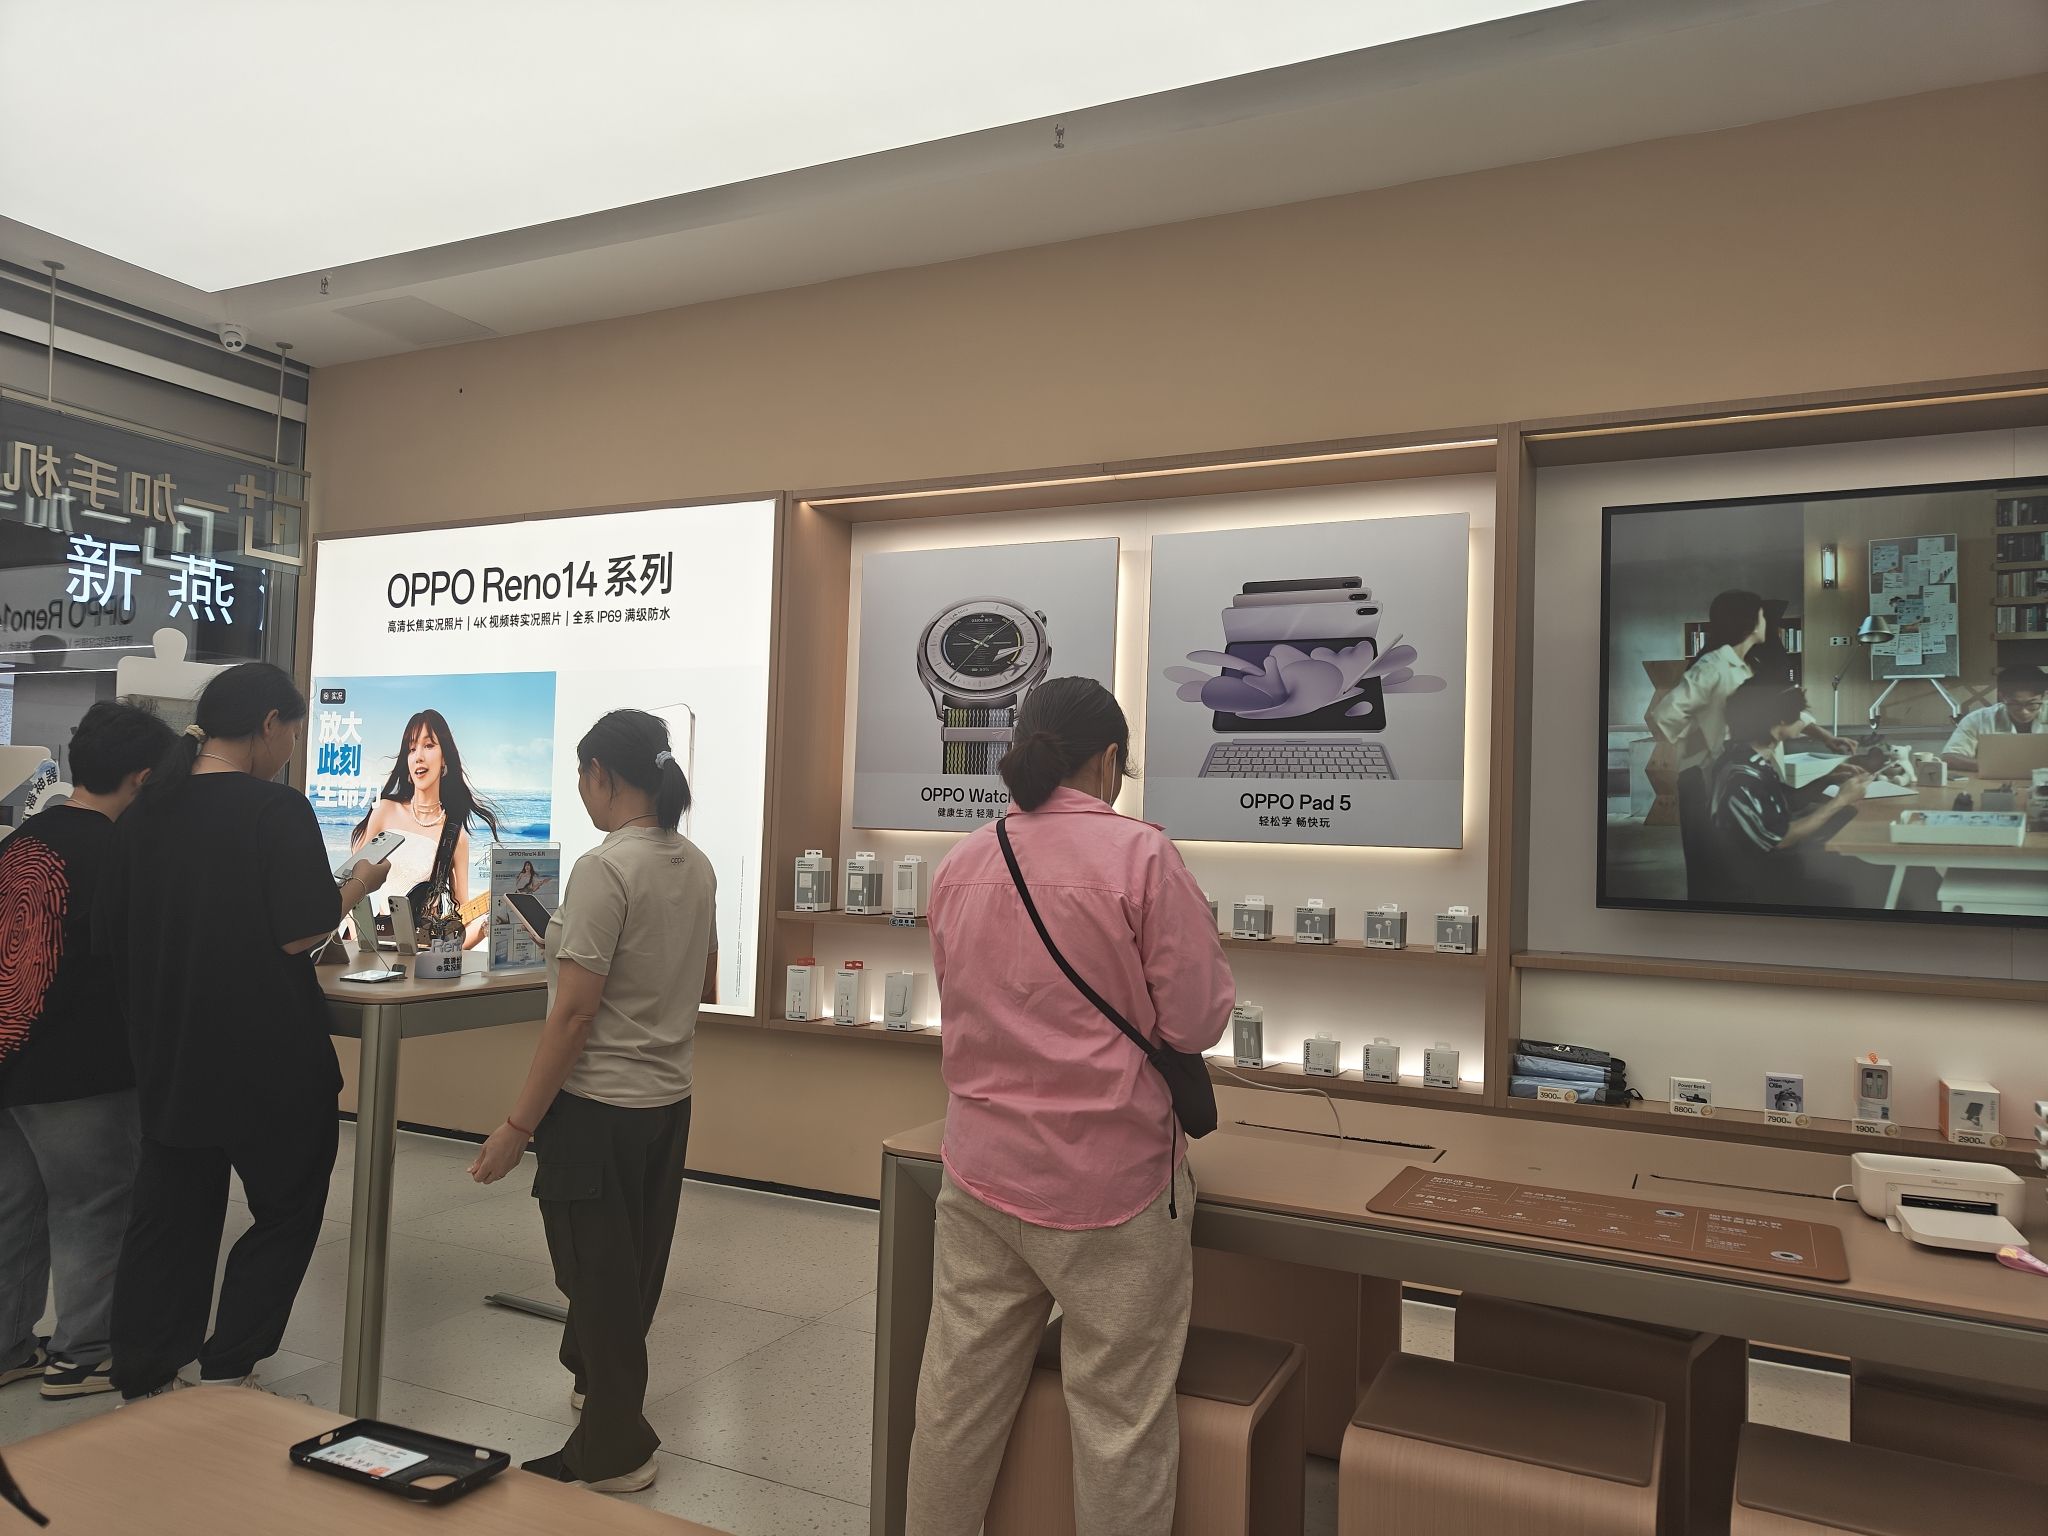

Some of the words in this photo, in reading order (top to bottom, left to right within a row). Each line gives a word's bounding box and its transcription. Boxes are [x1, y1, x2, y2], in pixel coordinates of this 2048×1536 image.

[387, 568, 475, 608] OPPO
[482, 560, 597, 603] Reno14
[604, 551, 673, 597] 系列
[387, 617, 463, 633] 高清长焦实况照片
[473, 616, 487, 629] 4K
[489, 612, 562, 628] 视频转实况照片
[573, 611, 594, 624] 全系
[597, 609, 622, 623] IP69
[625, 606, 671, 622] 满级防水
[319, 711, 362, 742] 放大
[317, 743, 361, 776] 此刻
[315, 783, 381, 809] 生命力
[921, 787, 965, 802] OPPO
[1240, 793, 1295, 810] OPPO
[1300, 794, 1334, 810] Pad
[1340, 795, 1351, 811] 5
[938, 808, 973, 818] 健康生活
[977, 808, 1007, 819] 轻薄上
[1259, 816, 1292, 827] 轻松学
[1296, 816, 1331, 828] 畅快玩
[432, 939, 462, 953] Ren
[1540, 1092, 1557, 1100] 3900
[1673, 1105, 1693, 1114] 8800
[1767, 1115, 1787, 1124] 7900
[1855, 1125, 1875, 1134] 1900
[1958, 1135, 1980, 1145] 2900
